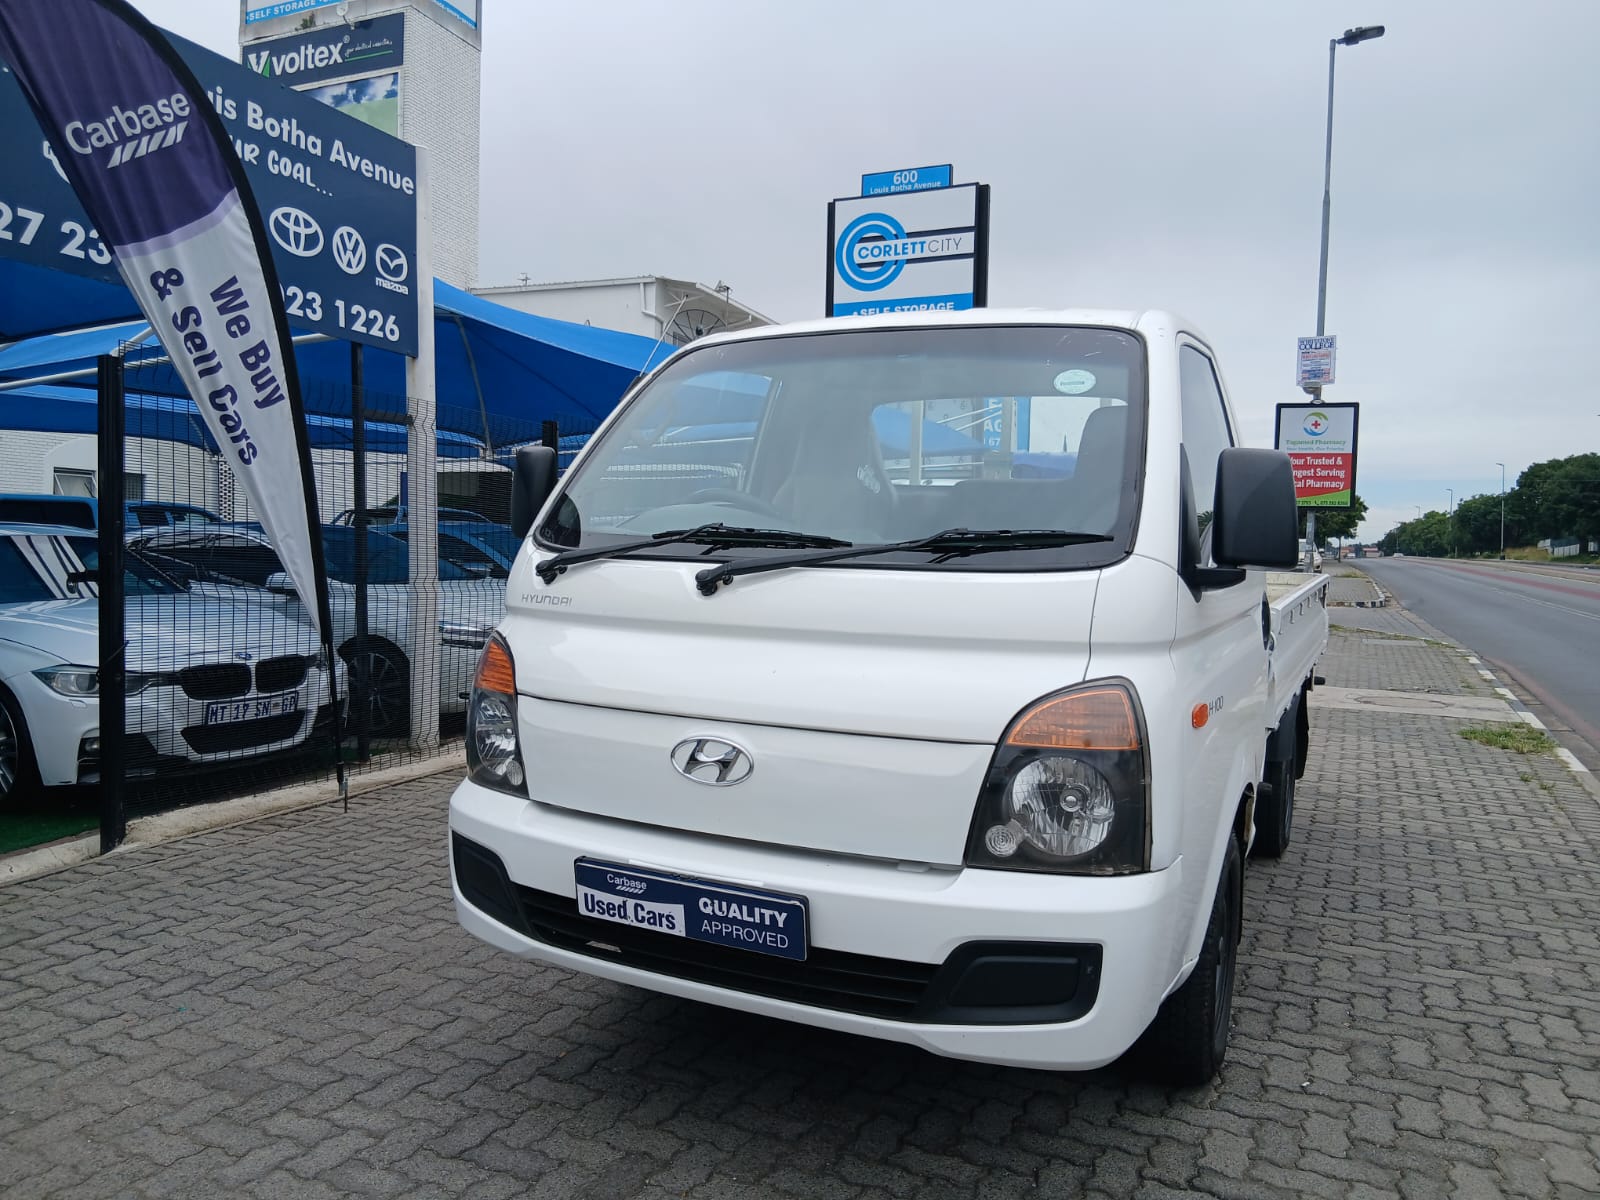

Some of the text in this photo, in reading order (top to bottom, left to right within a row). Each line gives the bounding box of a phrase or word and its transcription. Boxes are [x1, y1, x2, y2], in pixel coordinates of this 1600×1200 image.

[249, 0, 316, 21] SELF STORAGE
[65, 92, 191, 155] Carbase
[247, 100, 322, 157] Botha
[329, 139, 415, 195] Avenue
[870, 180, 941, 195] Louis Botha Avenue
[893, 170, 918, 185] 600
[375, 276, 409, 295] mazda
[334, 299, 400, 342] 1226
[209, 275, 286, 410] We Buy
[150, 267, 258, 466] & Sell Cars
[1306, 456, 1335, 465] Trusted
[1336, 457, 1343, 465] &
[1292, 468, 1345, 478] ngest Serving
[1305, 480, 1345, 490] Pharmacy
[521, 593, 573, 607] HYUNDAI
[606, 873, 648, 890] Carbase
[583, 892, 676, 931] Used Cars
[698, 897, 788, 928] QUALITY
[701, 919, 789, 950] APPROVED
